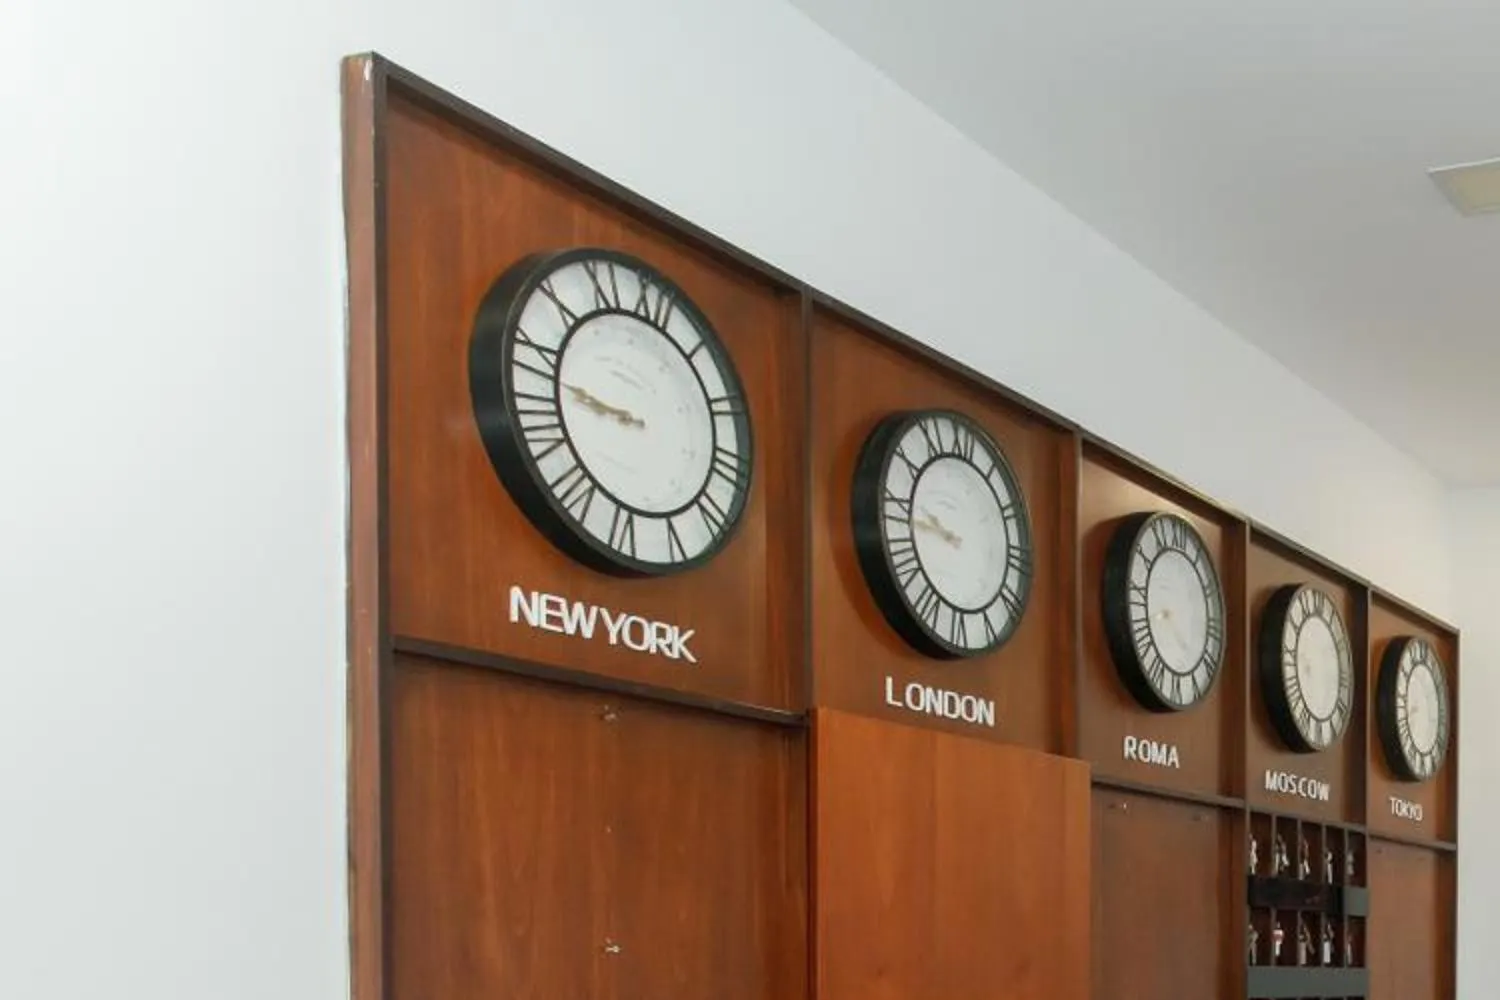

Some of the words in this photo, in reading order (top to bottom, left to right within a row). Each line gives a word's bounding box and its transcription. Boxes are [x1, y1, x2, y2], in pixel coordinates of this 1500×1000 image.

[886, 676, 995, 727] LONDON
[1124, 735, 1180, 769] ROMA
[1265, 769, 1330, 801] MOSCOW
[1390, 796, 1423, 821] TOKYO
